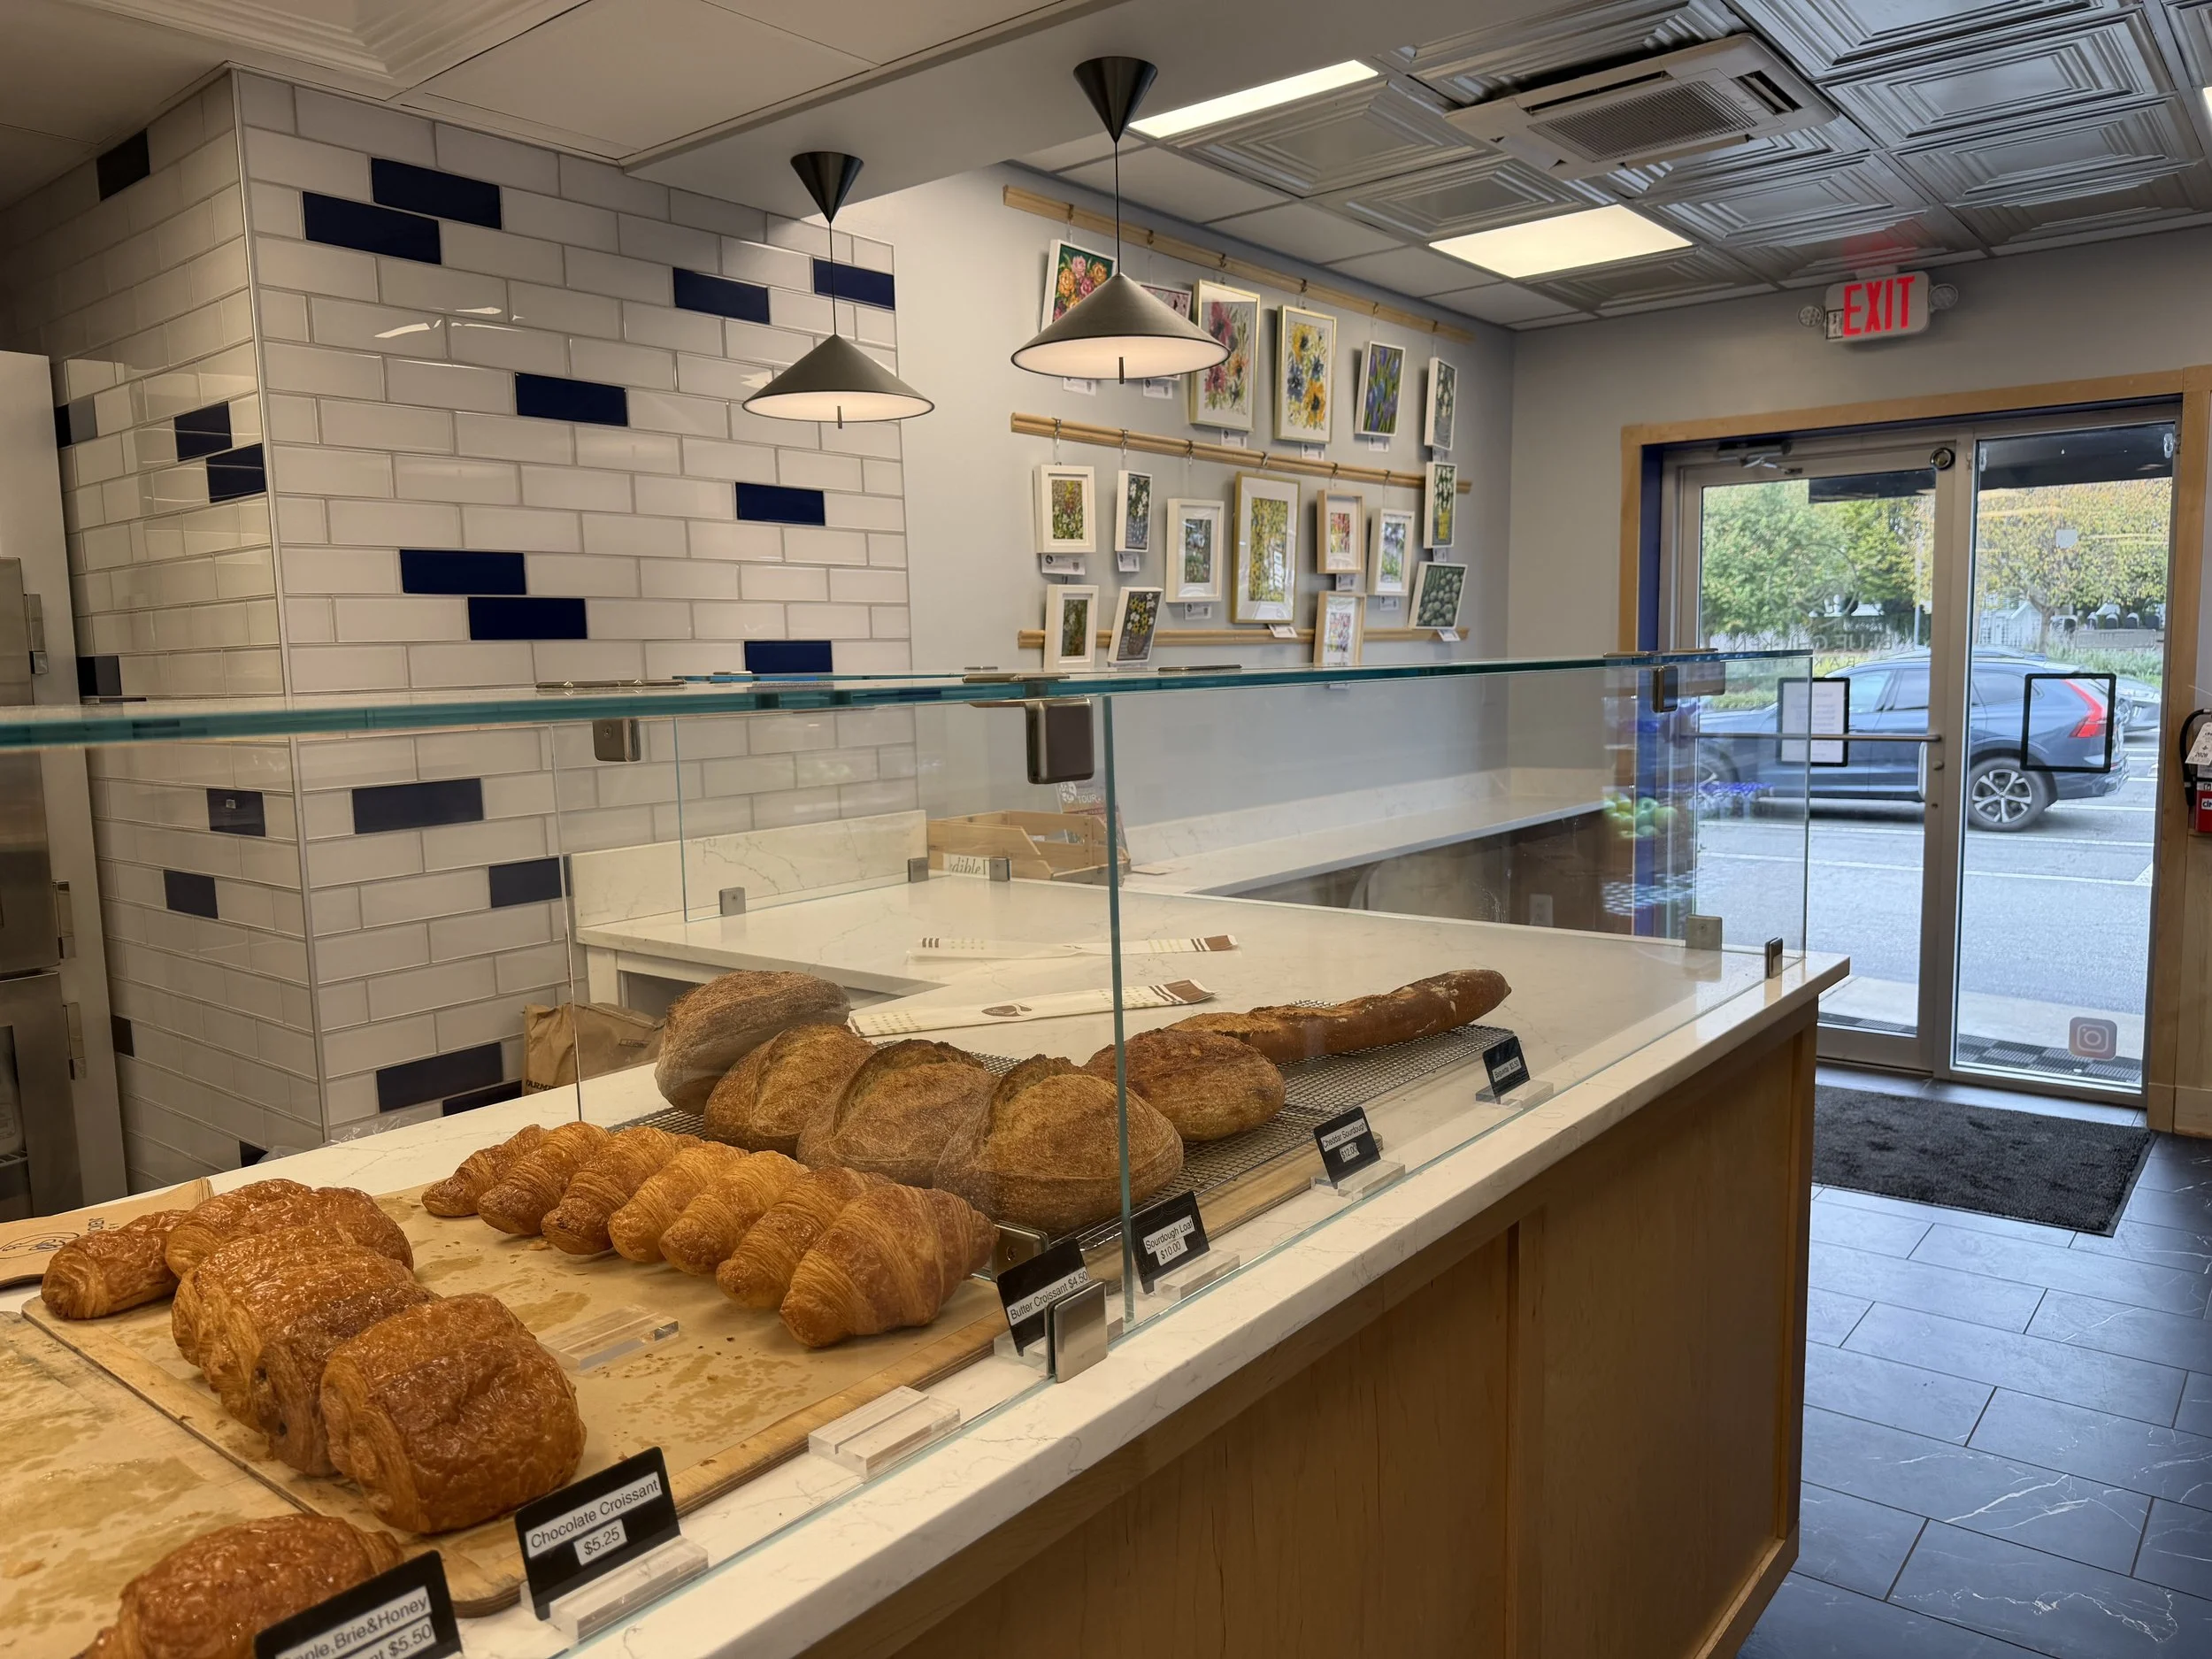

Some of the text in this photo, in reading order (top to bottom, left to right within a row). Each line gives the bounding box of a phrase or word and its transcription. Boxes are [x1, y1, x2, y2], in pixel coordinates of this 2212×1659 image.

[1843, 275, 1916, 336] EXIT
[1322, 1133, 1341, 1148] Cheddar
[1145, 1219, 1194, 1250] Sourdough Loaf
[1160, 1240, 1181, 1260] $10.00
[1010, 1271, 1088, 1320] Butter Croissant $4.50
[531, 1479, 659, 1548] Chocolate Croissant
[583, 1526, 620, 1555] $5.25
[388, 1624, 434, 1657] $5.50
